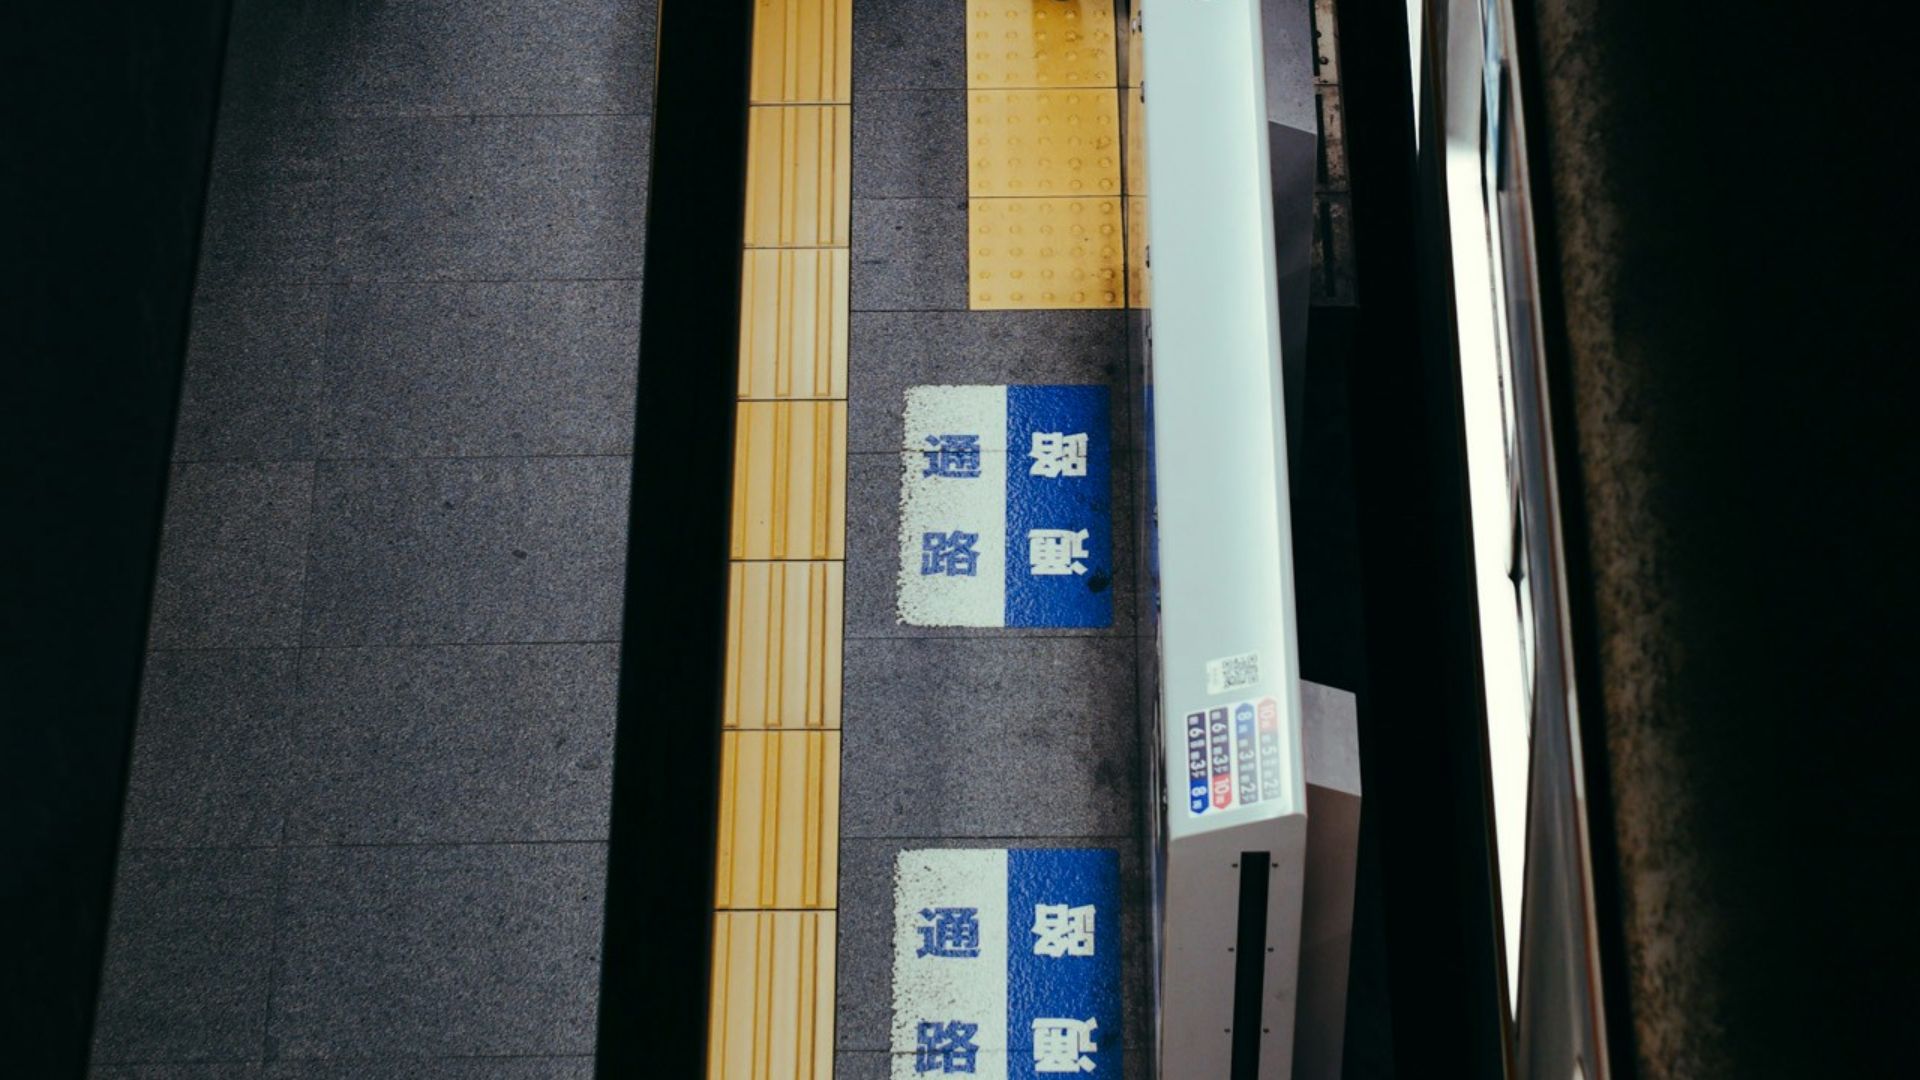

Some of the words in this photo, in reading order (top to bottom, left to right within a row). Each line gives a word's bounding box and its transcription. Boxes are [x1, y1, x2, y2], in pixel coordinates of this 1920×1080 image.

[921, 434, 981, 576] 通路
[1028, 431, 1089, 575] 通路
[915, 907, 981, 1074] 通路
[1031, 904, 1097, 1073] 通路
